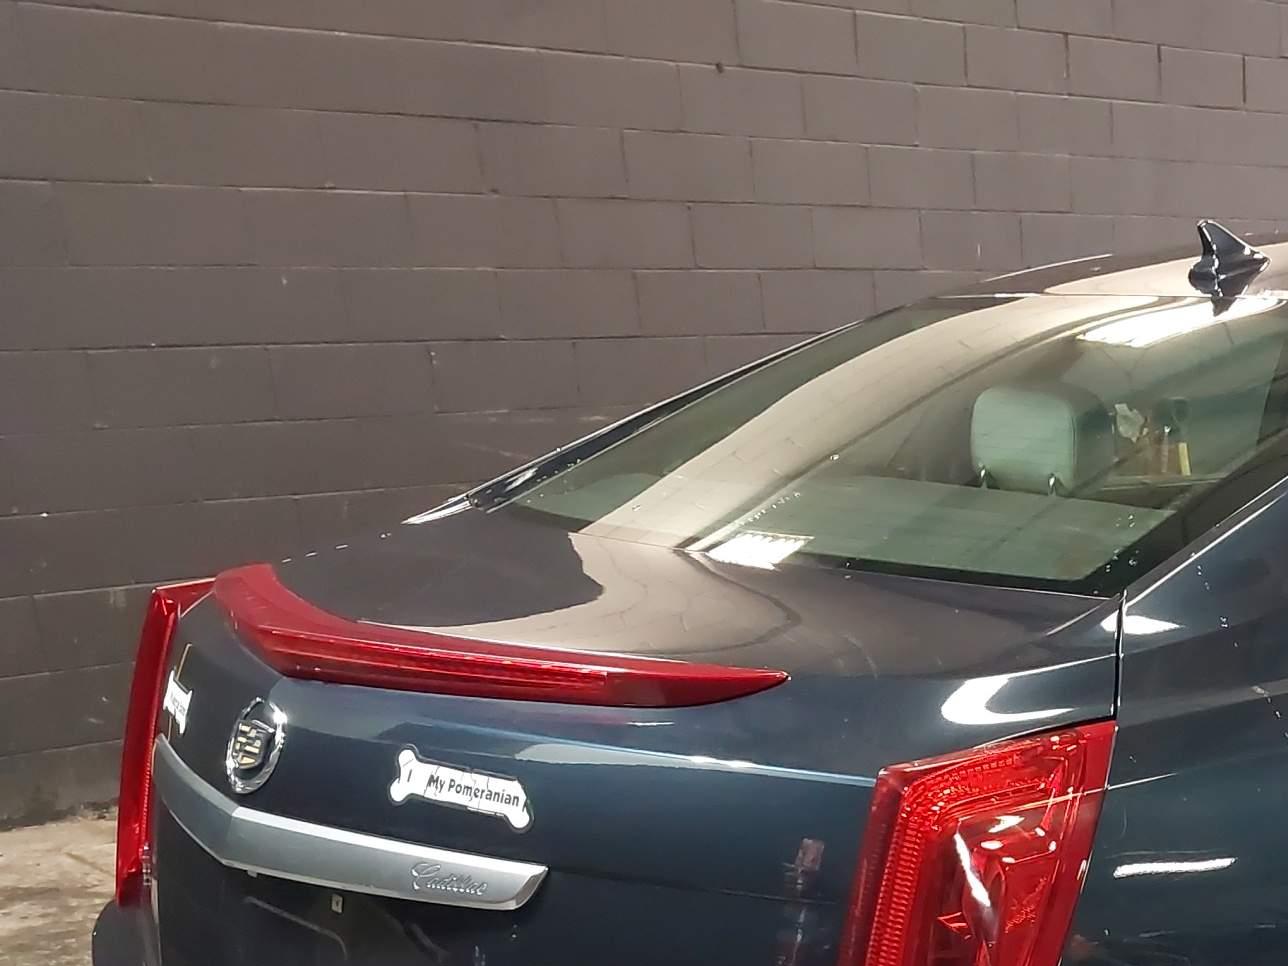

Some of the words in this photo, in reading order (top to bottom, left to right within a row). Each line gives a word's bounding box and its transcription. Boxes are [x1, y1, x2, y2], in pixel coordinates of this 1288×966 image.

[428, 774, 445, 793] My
[448, 779, 520, 807] Pomeranian
[411, 862, 488, 895] Cadillac
